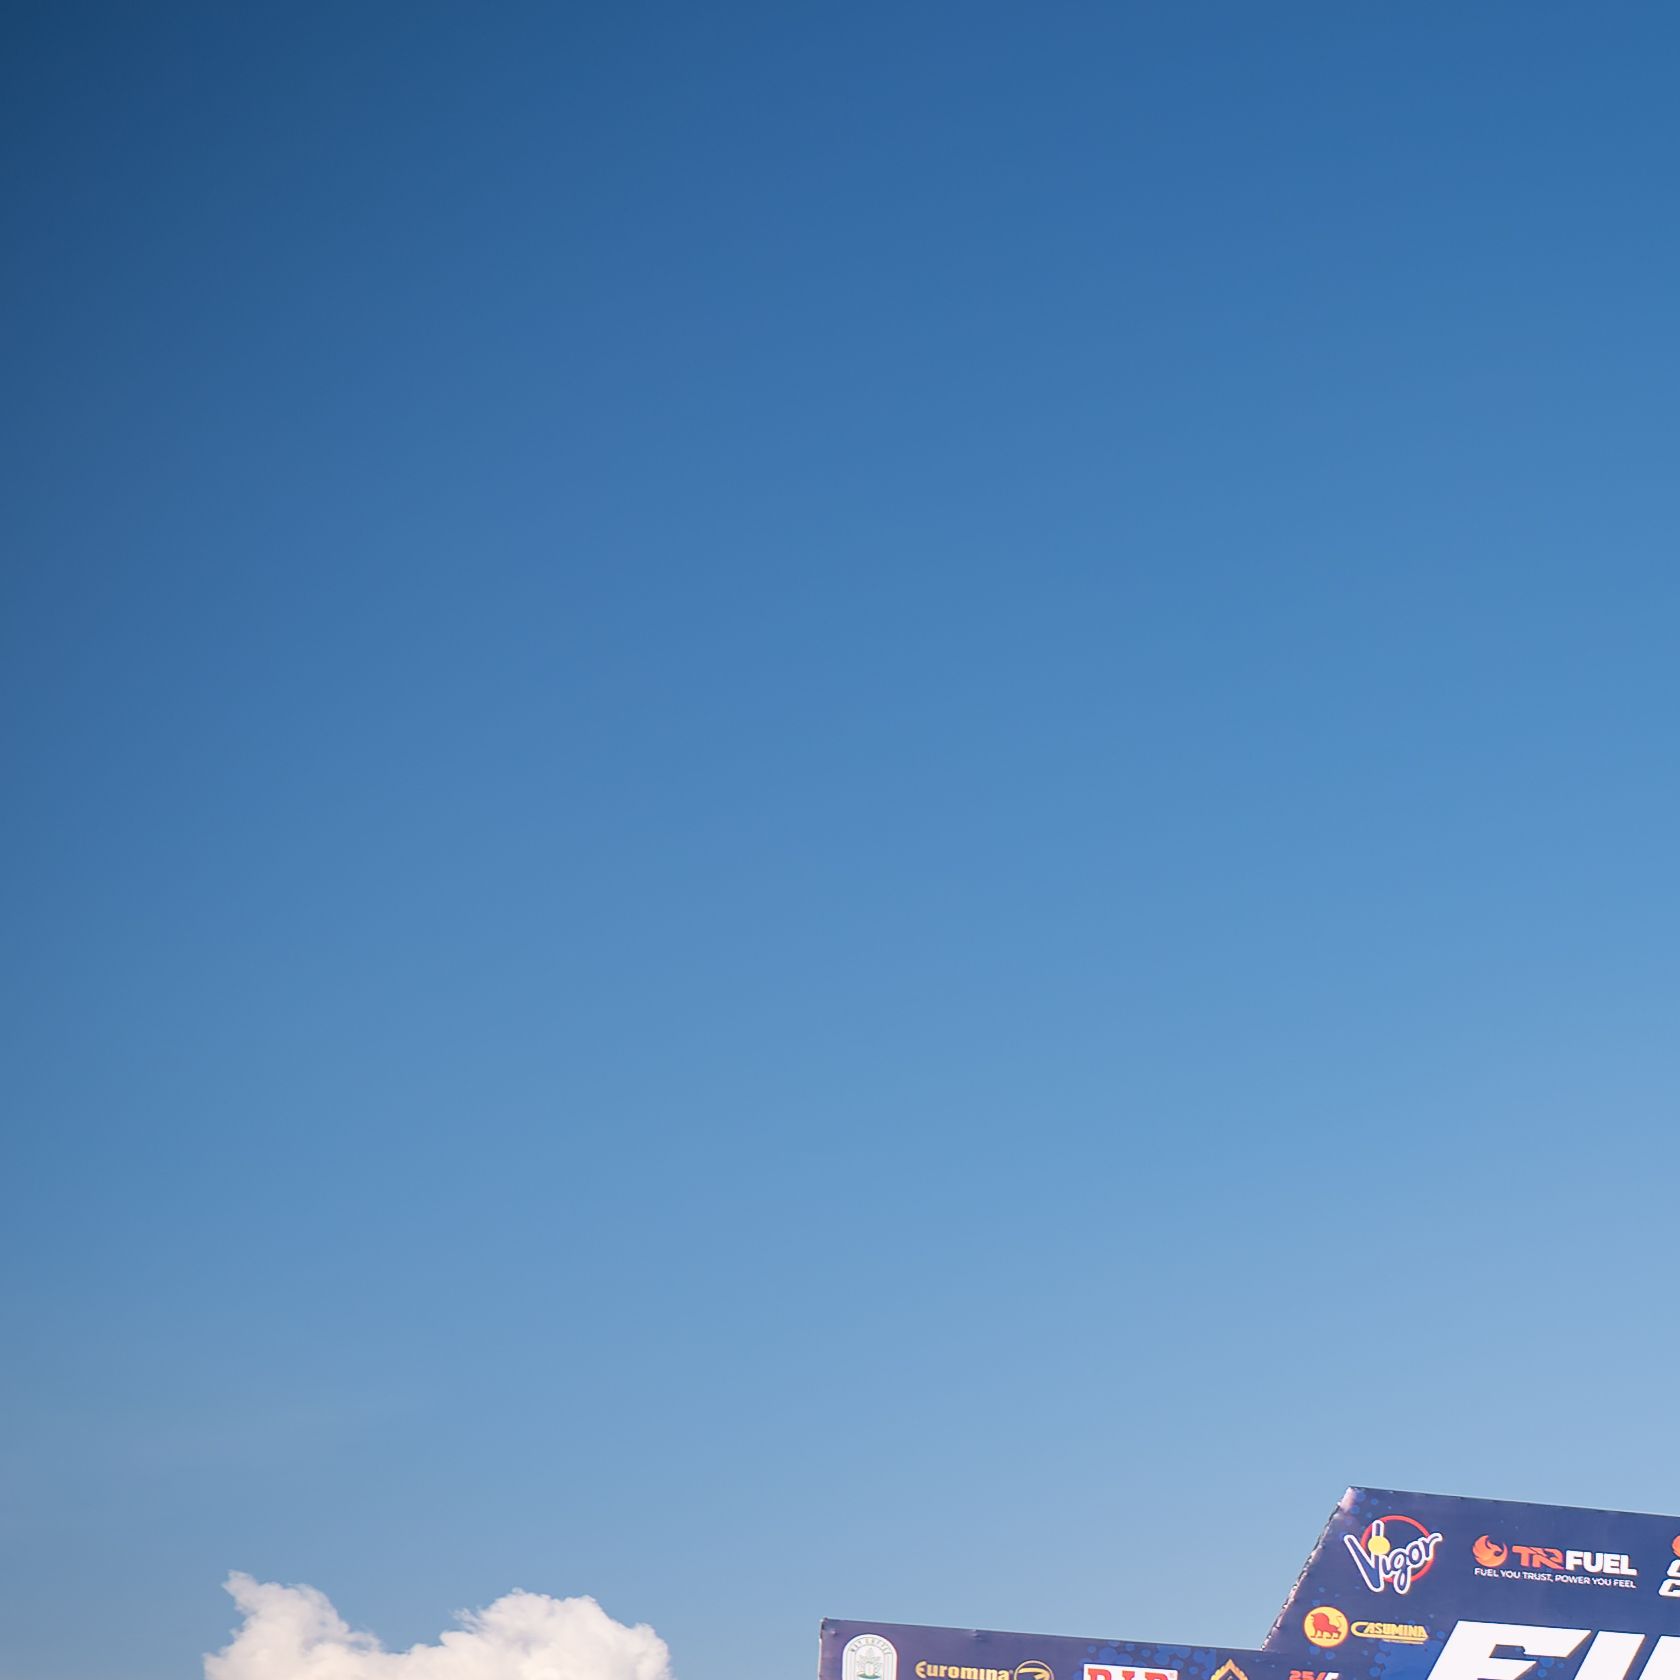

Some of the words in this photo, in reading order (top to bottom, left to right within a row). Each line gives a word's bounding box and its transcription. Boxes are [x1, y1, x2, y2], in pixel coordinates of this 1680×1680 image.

[1344, 1520, 1443, 1594] Vigor
[1474, 1567, 1499, 1578] FUEL
[1501, 1569, 1521, 1579] YOU
[1523, 1571, 1553, 1582] TRUST,
[1555, 1574, 1591, 1585] POWER
[1592, 1577, 1612, 1587] YOU
[1613, 1579, 1637, 1588] FEEL
[1351, 1621, 1429, 1641] CASUMINA
